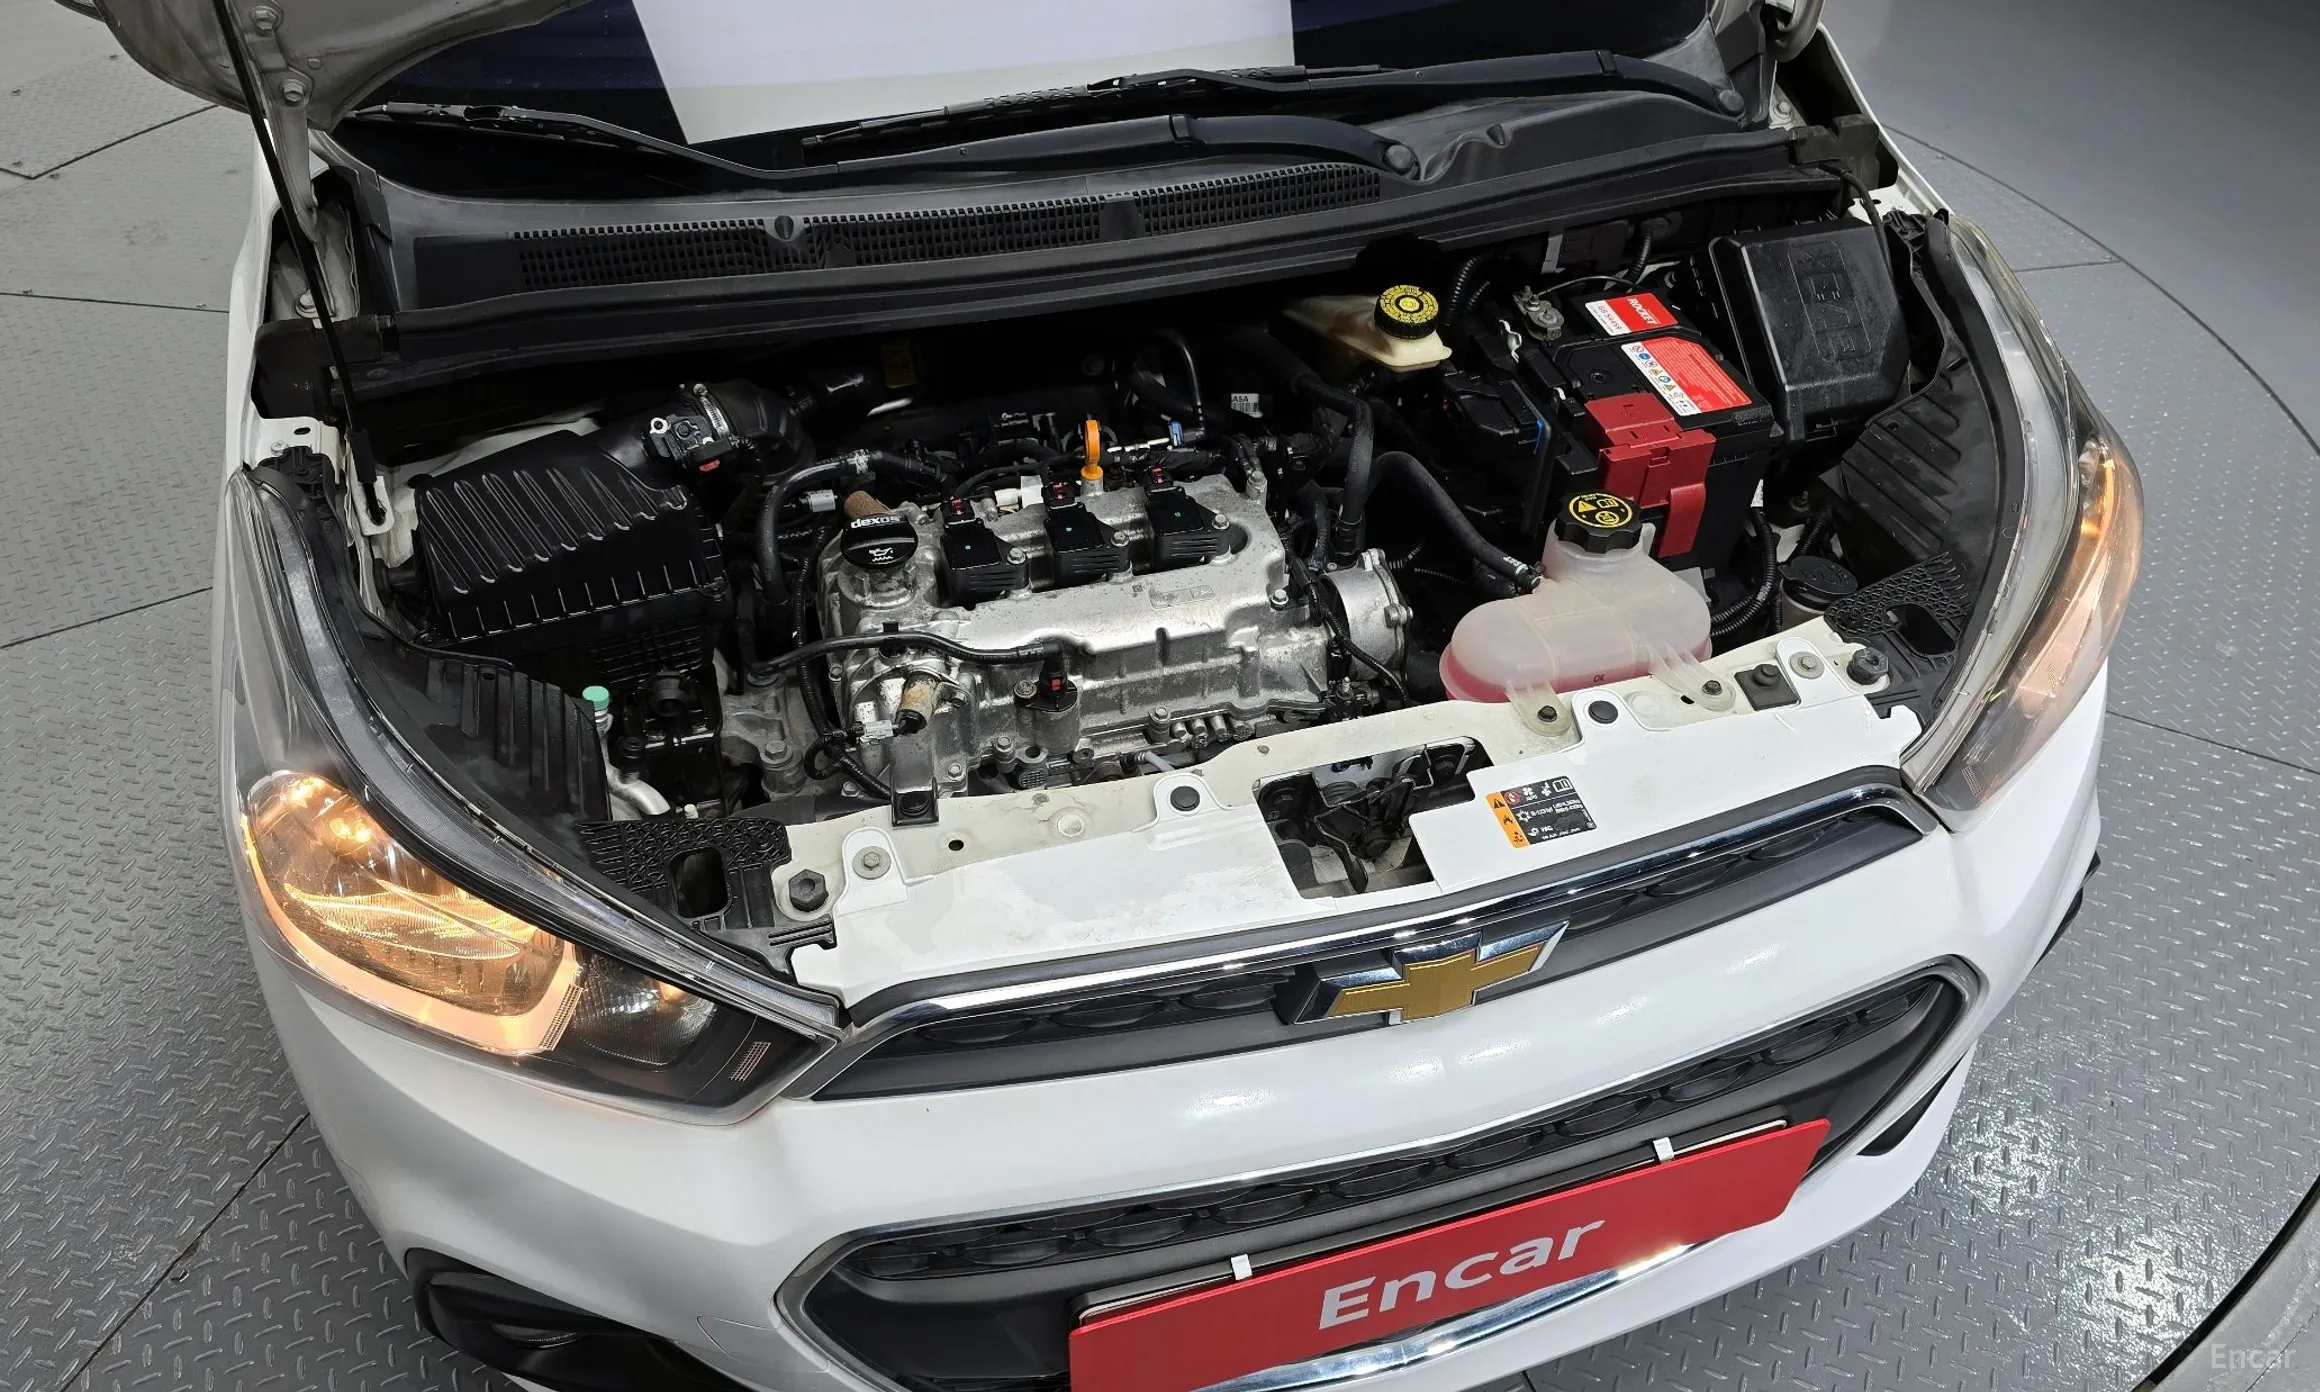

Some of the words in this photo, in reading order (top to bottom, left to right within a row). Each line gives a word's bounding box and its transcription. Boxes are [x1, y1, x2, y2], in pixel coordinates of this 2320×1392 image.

[1626, 296, 1658, 325] ROCKET
[850, 516, 901, 529] dexos
[1319, 1219, 1605, 1330] Encar
